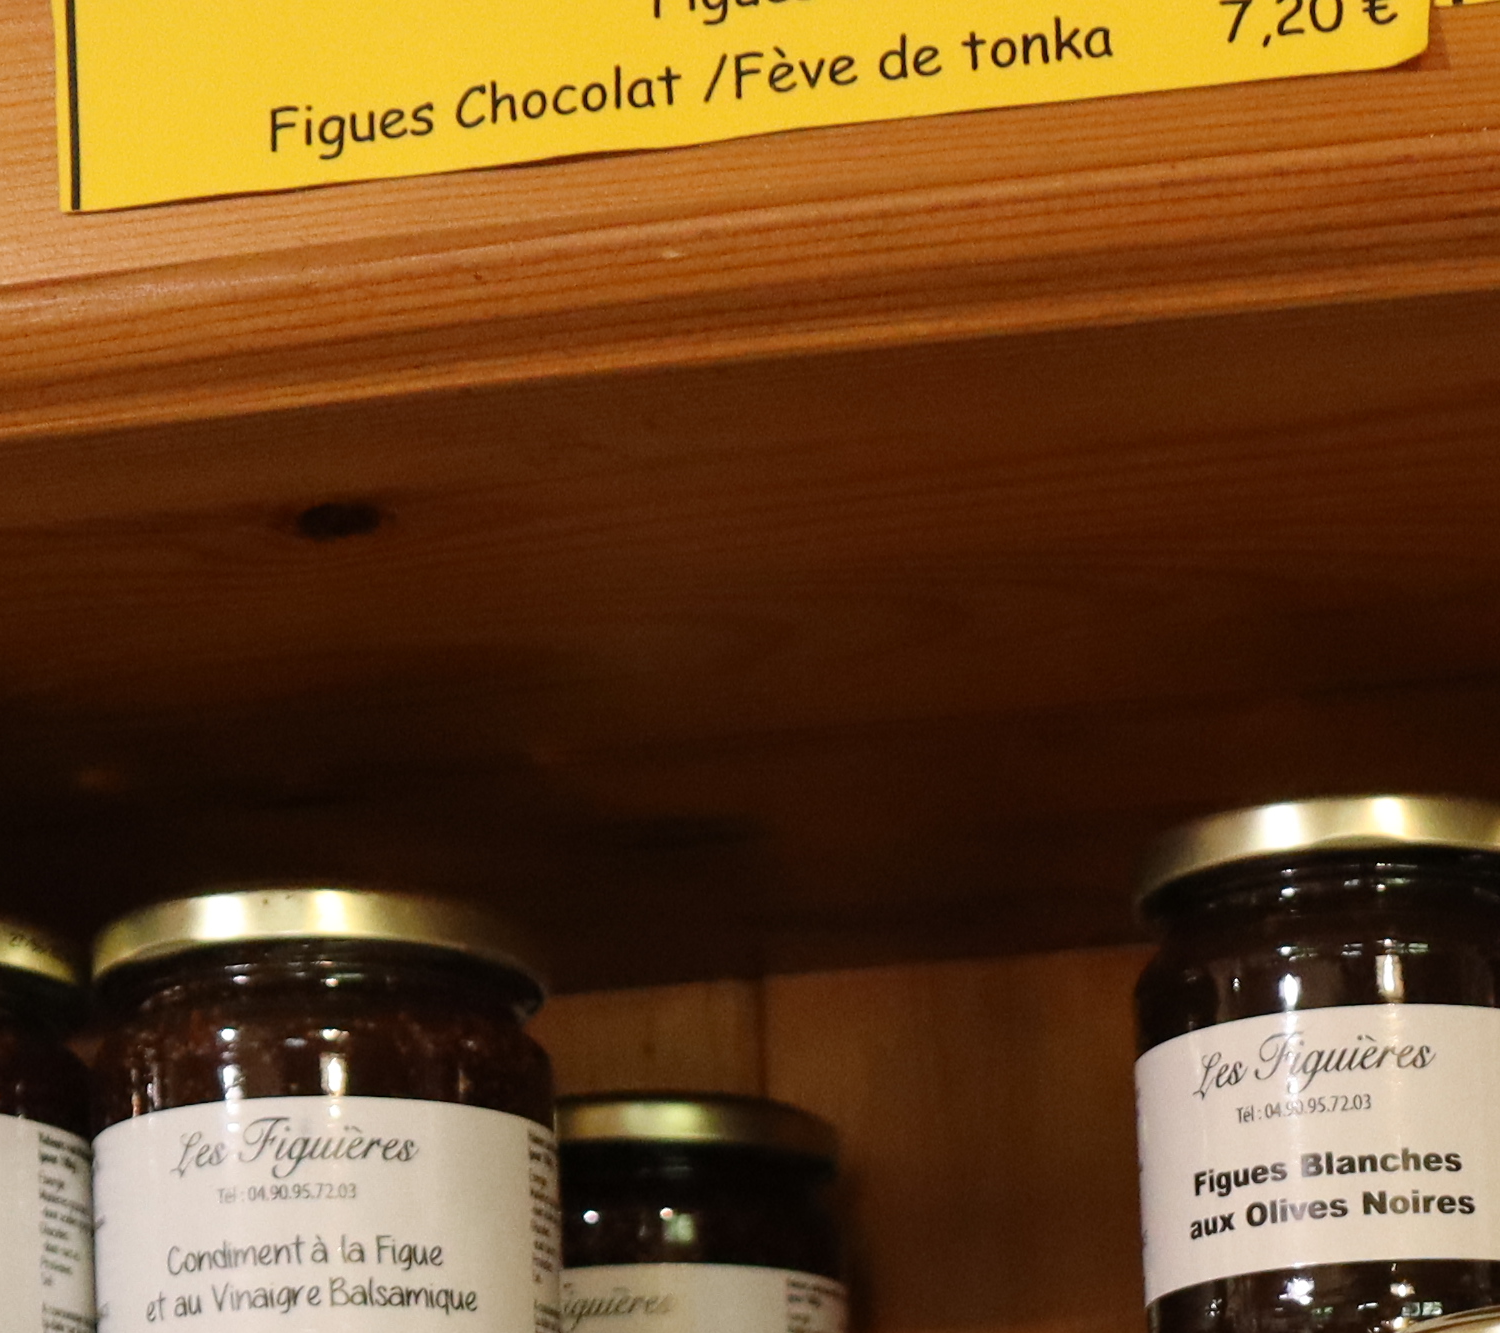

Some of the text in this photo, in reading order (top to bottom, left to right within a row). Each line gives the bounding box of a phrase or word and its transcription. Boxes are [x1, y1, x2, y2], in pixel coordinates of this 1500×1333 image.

[269, 103, 434, 159] Figues
[456, 65, 682, 128] Chocolat
[879, 34, 942, 80] de
[963, 17, 1113, 71] tonka
[1193, 1032, 1436, 1100] Les Figuières
[171, 1116, 418, 1178] Les Figuières
[1193, 1147, 1462, 1197] Figues Blanches
[1189, 1189, 1475, 1240] aux Olives Noires
[167, 1234, 444, 1276] Condiment à la Figue
[146, 1277, 478, 1322] et au Vinaigre Balsamique
